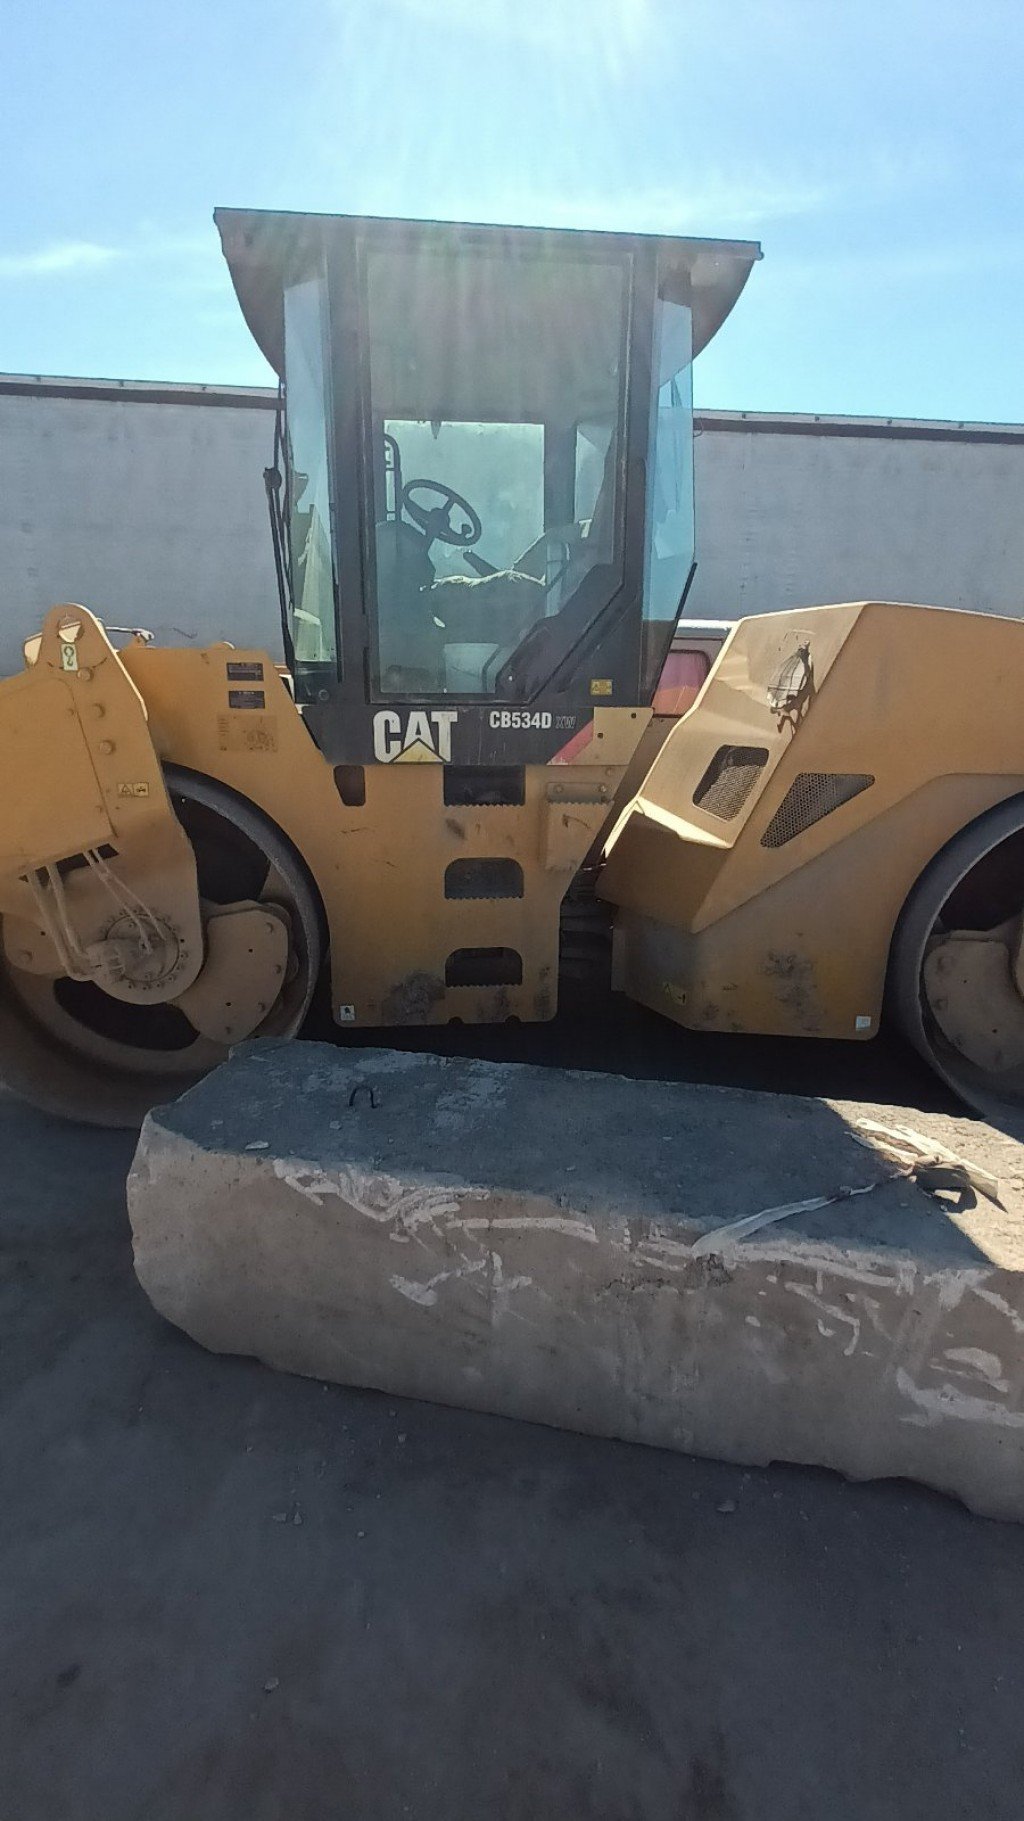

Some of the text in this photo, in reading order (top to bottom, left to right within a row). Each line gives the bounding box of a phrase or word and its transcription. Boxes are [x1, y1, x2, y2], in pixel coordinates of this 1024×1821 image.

[373, 710, 458, 763] CAT
[489, 711, 576, 729] CB534D XW
